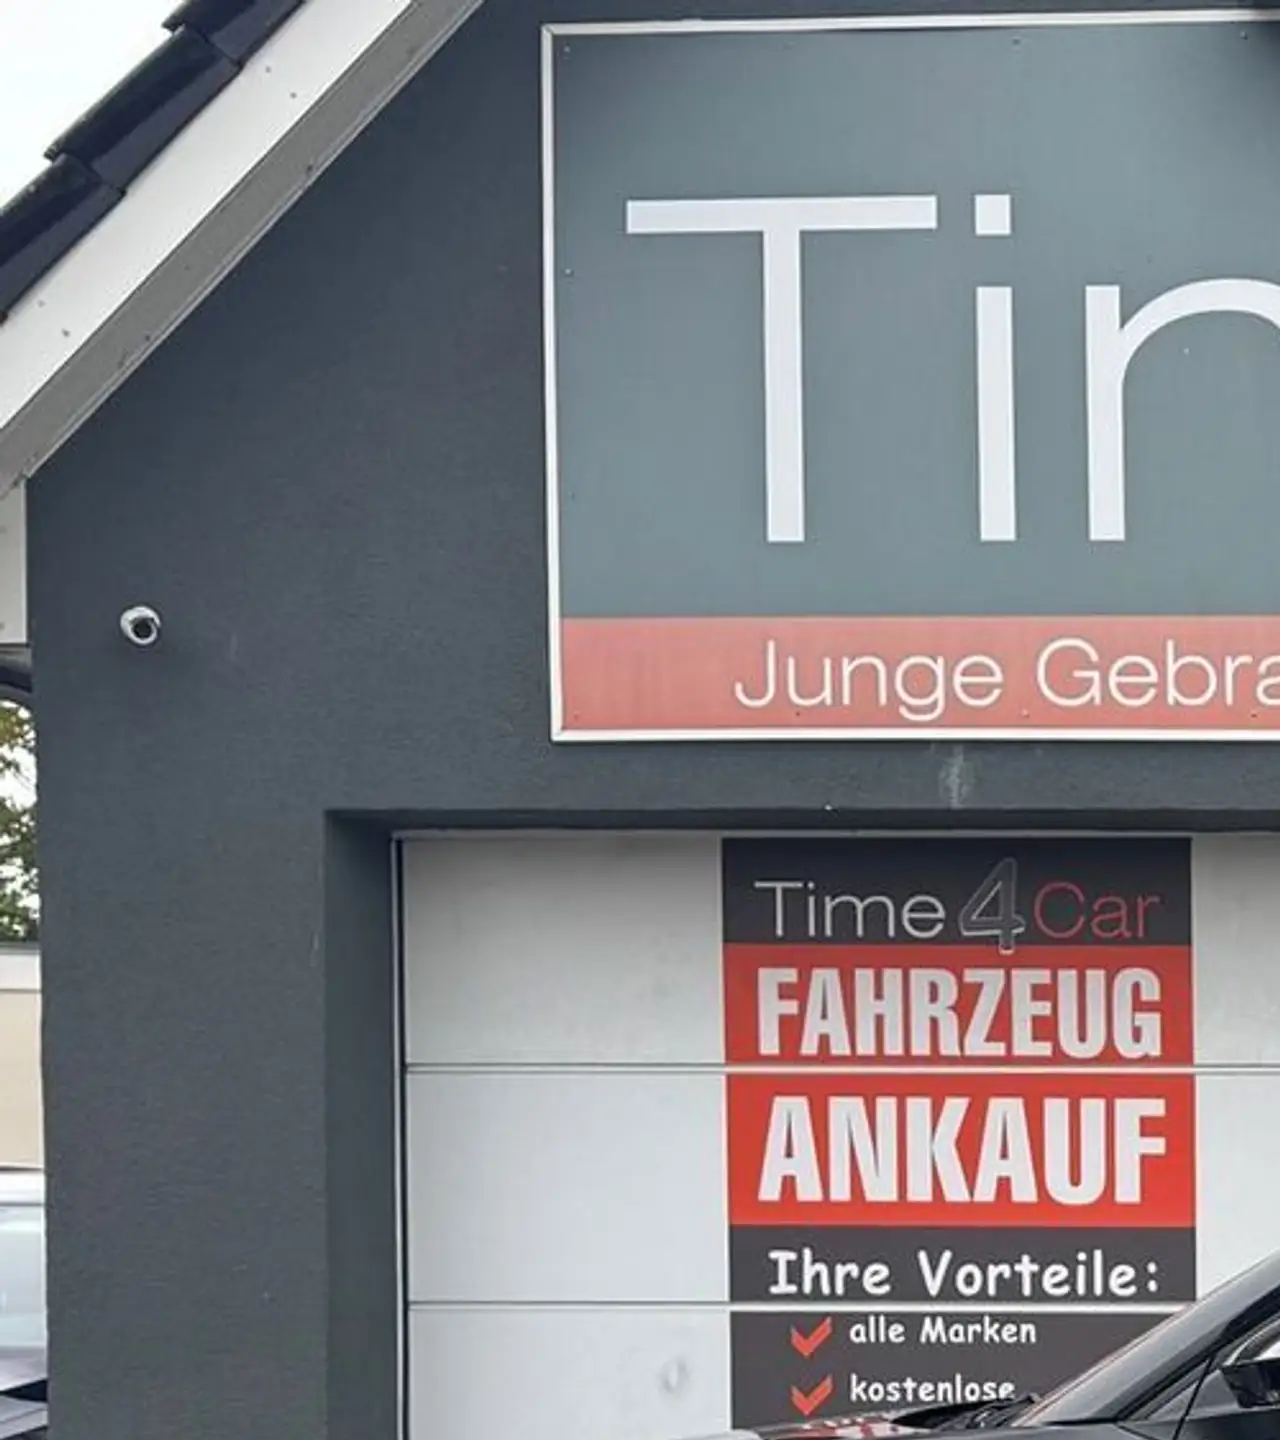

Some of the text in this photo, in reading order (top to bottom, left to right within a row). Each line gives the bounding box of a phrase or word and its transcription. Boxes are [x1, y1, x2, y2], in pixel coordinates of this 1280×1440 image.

[733, 637, 1004, 721] Junge
[754, 880, 946, 939] Time
[1033, 881, 1162, 938] Car
[756, 967, 1163, 1060] FAHRZEUG
[757, 1095, 1168, 1206] ANKAUF
[768, 1249, 1161, 1298] Ihre Vorteile:
[849, 1315, 1037, 1344] alle Marken
[849, 1373, 1017, 1404] kostenlose
